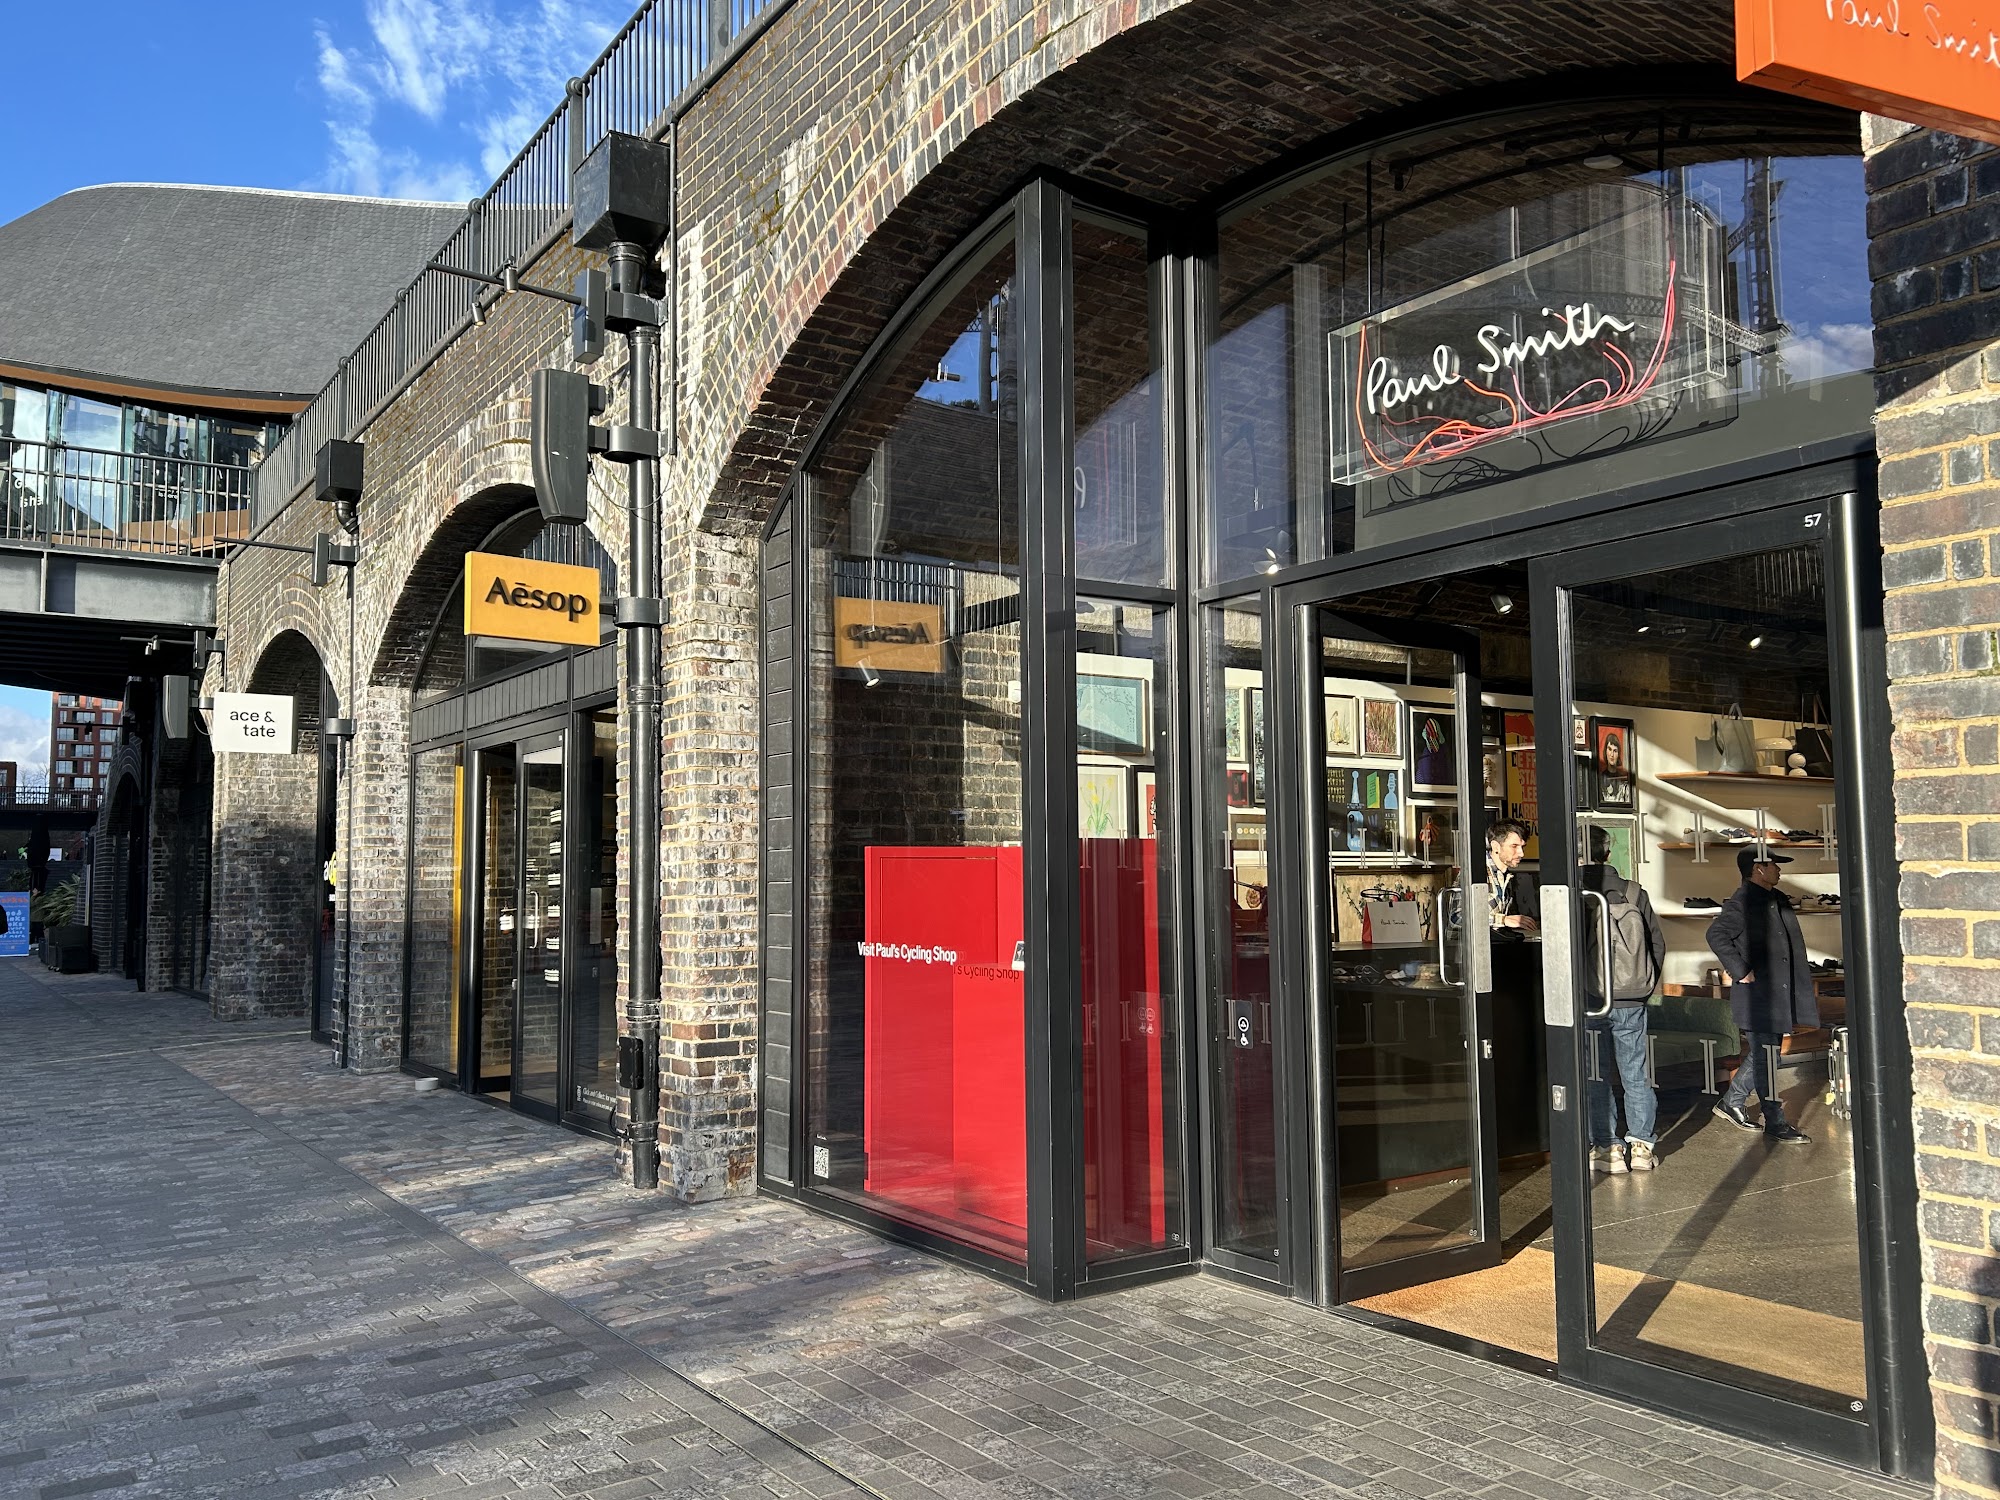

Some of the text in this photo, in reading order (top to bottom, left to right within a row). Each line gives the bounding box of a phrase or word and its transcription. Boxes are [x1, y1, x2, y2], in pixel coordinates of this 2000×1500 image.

[1924, 2, 2000, 69] Smit
[1366, 302, 1634, 415] Paul Smith
[1804, 513, 1822, 528] 57
[485, 576, 588, 622] Aēsop
[230, 711, 275, 723] ace &
[243, 724, 276, 738] tate
[857, 942, 957, 966] Visit Paul's Cycling Shop
